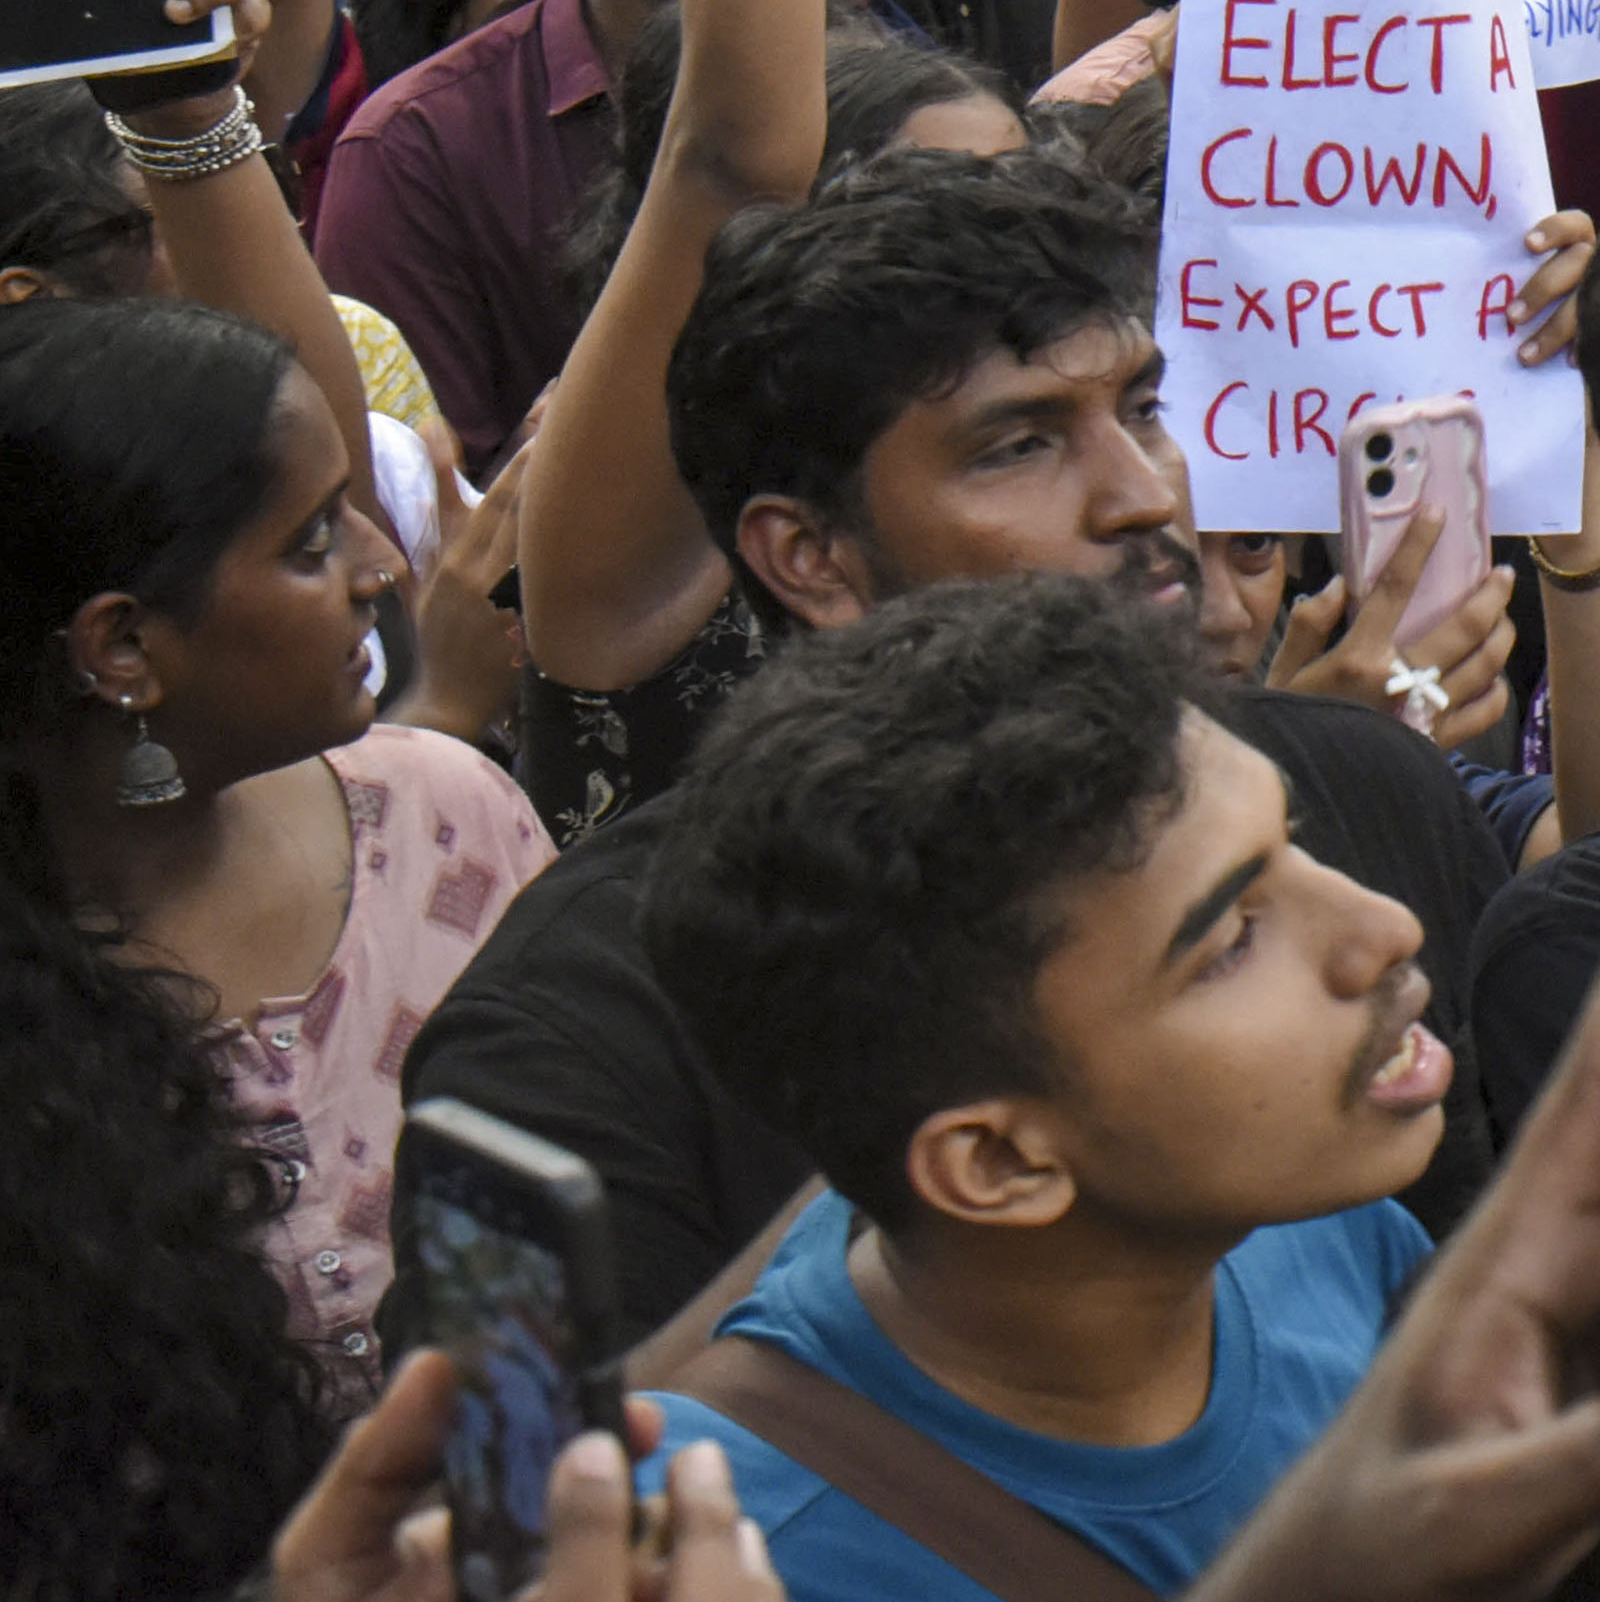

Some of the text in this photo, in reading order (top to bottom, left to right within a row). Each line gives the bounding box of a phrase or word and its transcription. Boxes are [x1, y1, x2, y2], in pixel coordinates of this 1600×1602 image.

[1490, 14, 1516, 93] A
[1201, 129, 1498, 220] CLOWN,
[1179, 260, 1516, 349] EXPECT A
